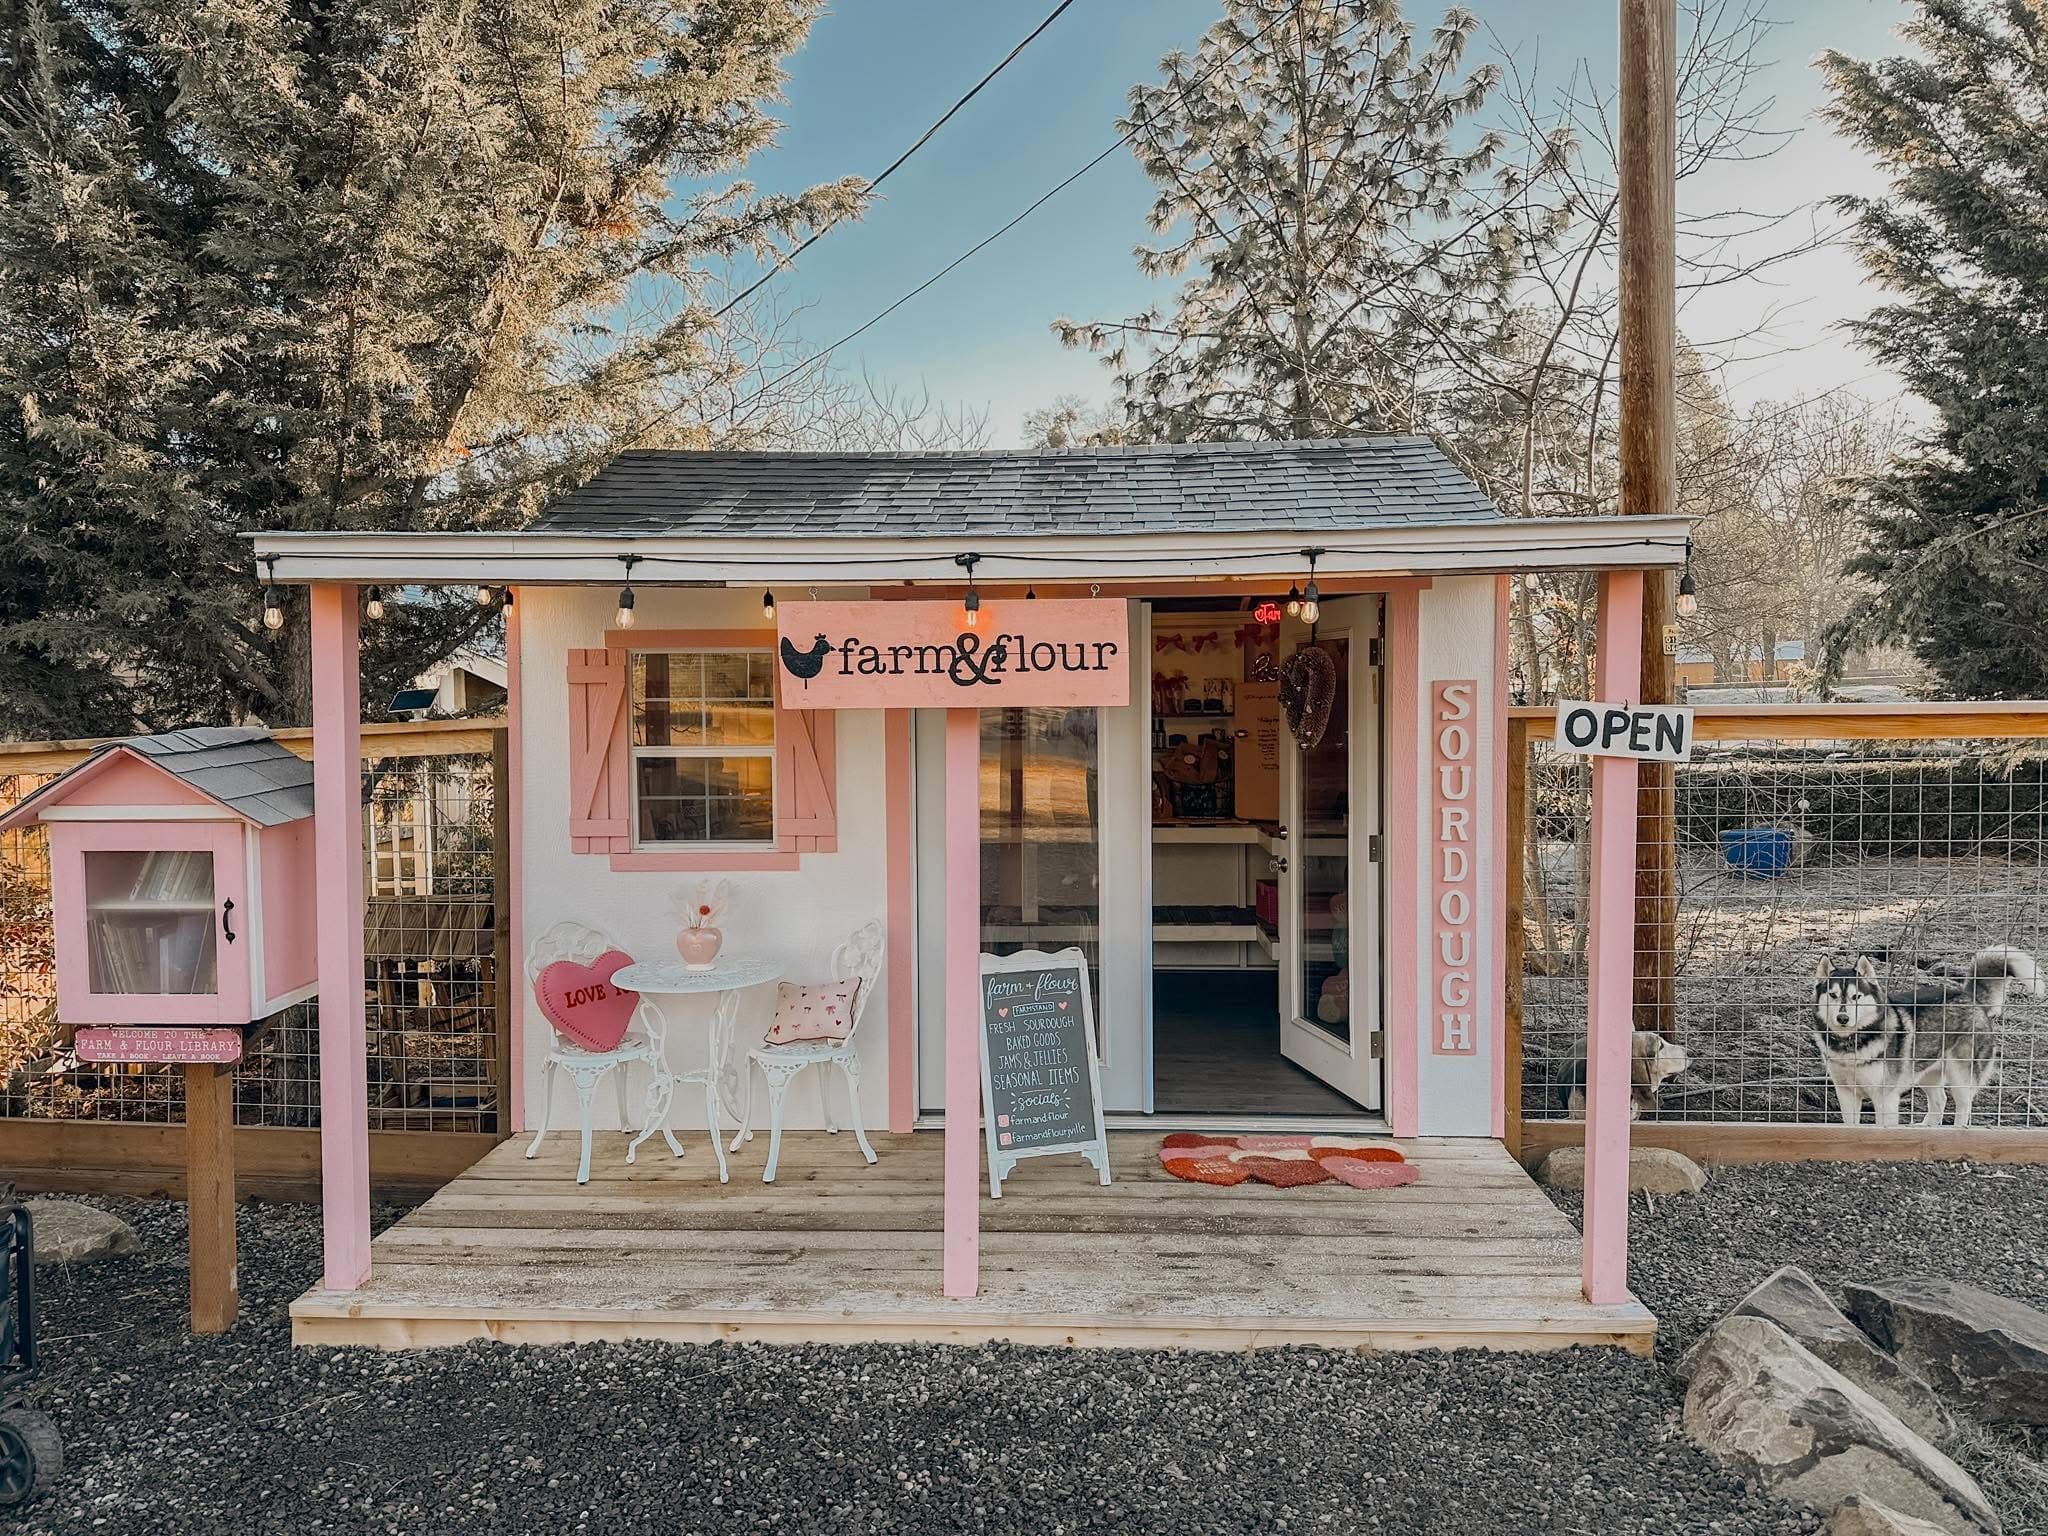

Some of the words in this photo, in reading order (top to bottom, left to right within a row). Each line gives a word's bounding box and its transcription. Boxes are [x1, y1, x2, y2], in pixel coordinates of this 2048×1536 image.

[1564, 708, 1684, 755] OPEN
[1439, 685, 1471, 1050] SOURDOUGH
[564, 983, 607, 1009] LOVE
[987, 977, 1024, 1010] farm
[1035, 973, 1079, 1001] flour
[1015, 1003, 1053, 1015] FARMSTAND
[111, 1030, 158, 1039] WELCOME
[164, 1031, 177, 1039] TO
[184, 1031, 206, 1039] THE
[989, 1021, 1016, 1034] FRESH
[1024, 1016, 1075, 1031] SOURDOUGH
[81, 1040, 112, 1050] FARM
[119, 1040, 128, 1050] &
[136, 1040, 173, 1051] FLOUR
[180, 1041, 235, 1051] LIBRARY
[1006, 1034, 1031, 1051] BAKED
[1034, 1031, 1061, 1047] GOODS
[998, 1053, 1023, 1070] JAMS
[1033, 1048, 1068, 1067] JELLIES
[993, 1069, 1043, 1090] SEASONAL
[1048, 1066, 1080, 1086] ITEMS
[1343, 1164, 1394, 1175] XOXO
